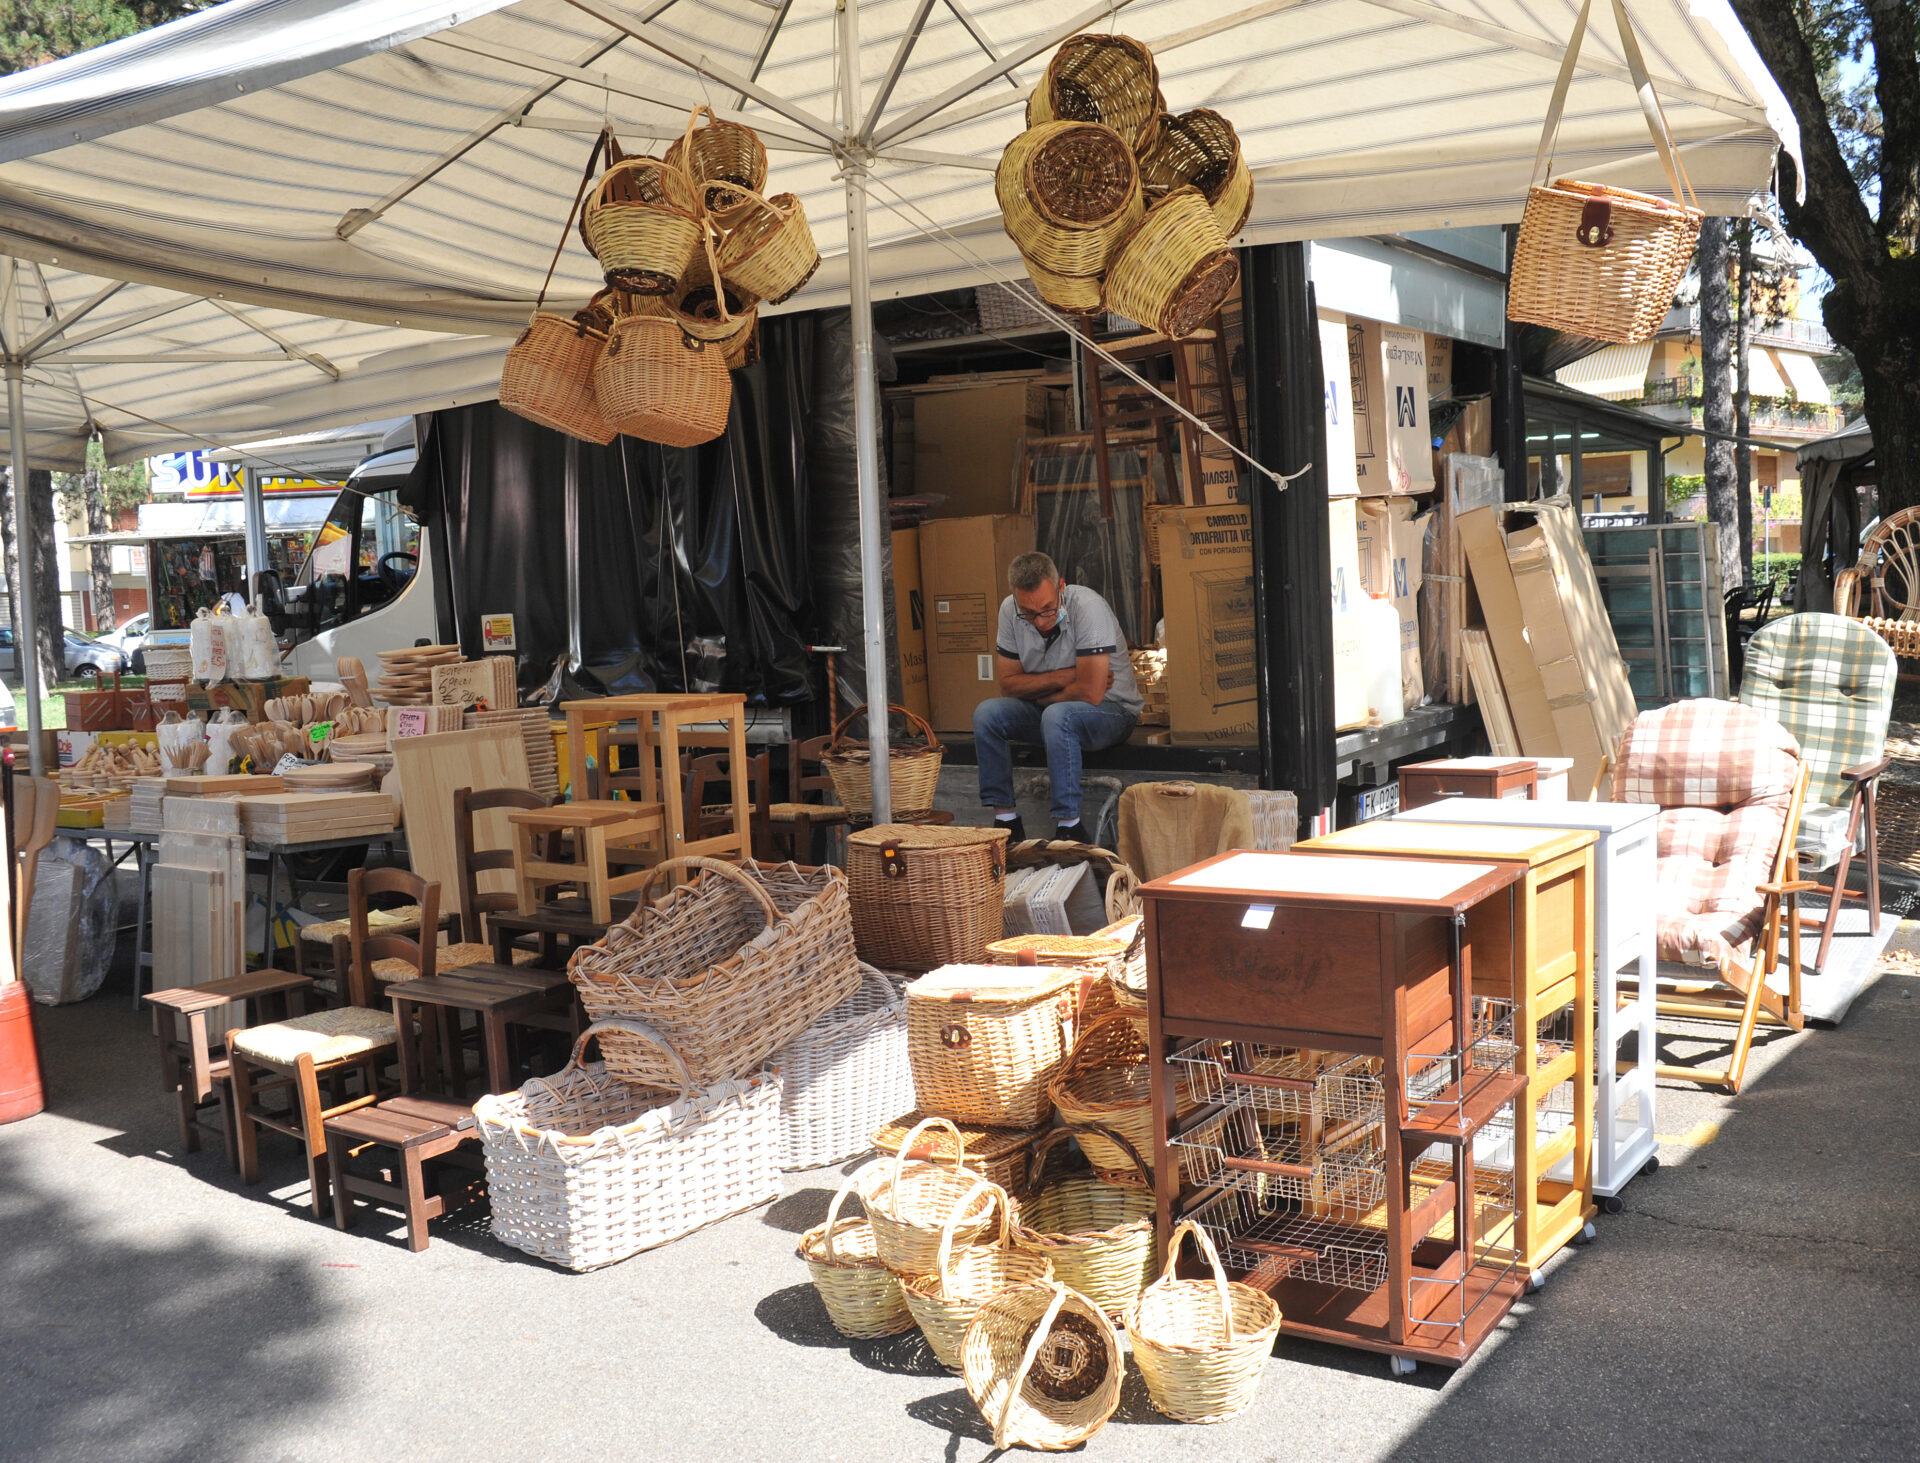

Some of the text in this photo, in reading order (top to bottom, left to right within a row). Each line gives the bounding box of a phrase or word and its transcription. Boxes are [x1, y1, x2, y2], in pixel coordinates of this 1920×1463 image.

[1357, 464, 1367, 476] VE
[1206, 514, 1248, 527] CARRELLO
[1357, 520, 1367, 531] NE
[1190, 529, 1252, 545] ORTAFRUTTA VE
[1199, 548, 1212, 556] CON
[903, 652, 924, 668] Mas
[1204, 720, 1259, 742] L'ORIGIN
[1365, 793, 1376, 817] FK
